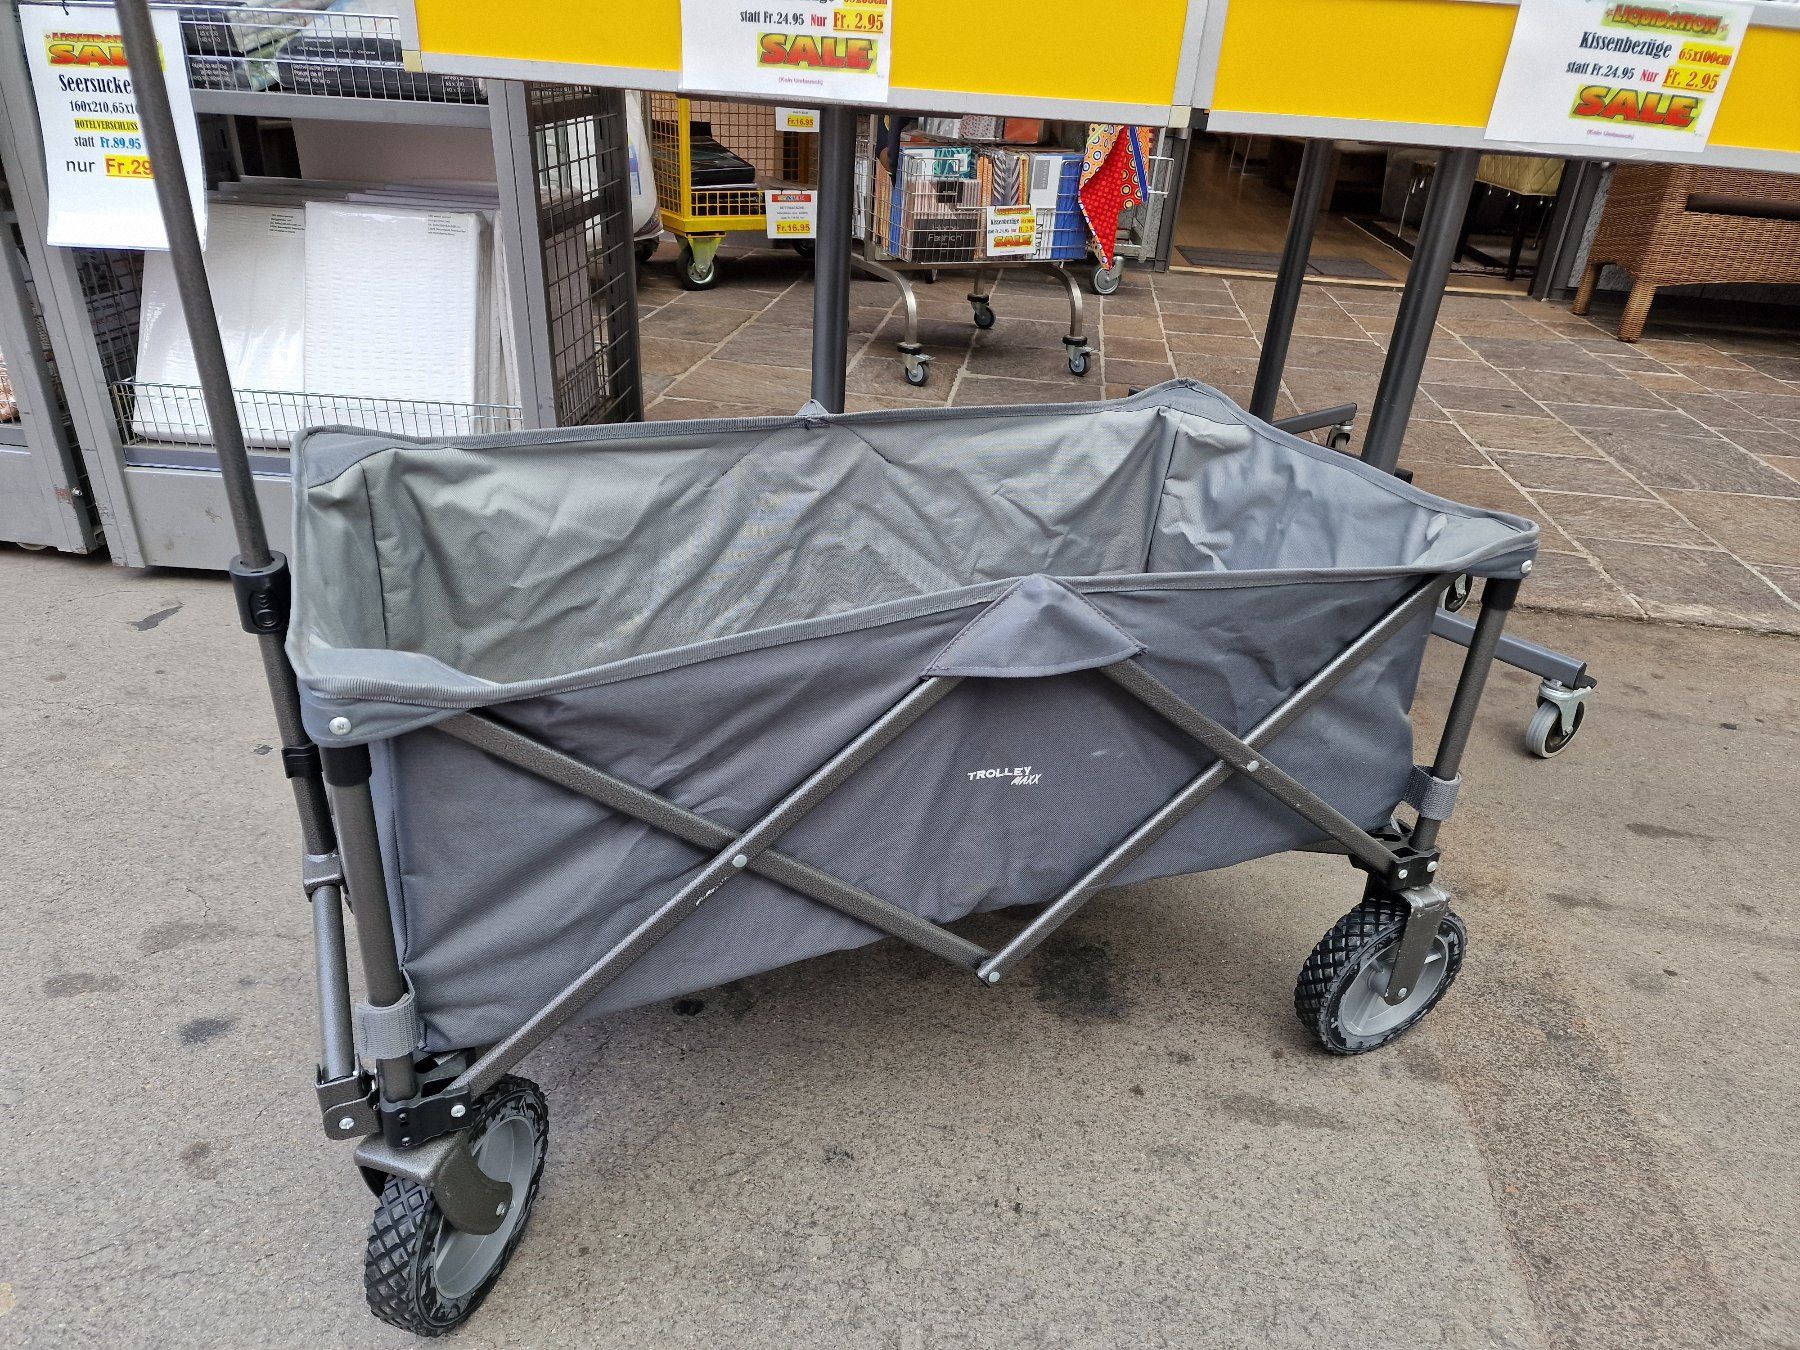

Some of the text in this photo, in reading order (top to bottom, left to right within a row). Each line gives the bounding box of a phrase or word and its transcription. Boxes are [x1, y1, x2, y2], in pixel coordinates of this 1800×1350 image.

[740, 10, 884, 30] statt Fr.24.95 Nur Fr. 2.95
[1612, 4, 1723, 34] LIQUIDATION
[49, 43, 129, 66] SAL
[760, 32, 873, 70] SALE
[1579, 31, 1732, 66] Kissenbezüge 65x100cm
[58, 74, 132, 94] Seersucke
[1566, 61, 1719, 90] statt Fr.24.95 Nur Fr. 2.95
[1573, 85, 1699, 128] SALE
[74, 119, 139, 131] HOTELVERSCHLUSS
[787, 117, 814, 126] Fr.16.95
[74, 135, 142, 149] statt Fr.89.95
[66, 159, 96, 172] nur
[776, 224, 811, 232] Fr.16.95
[993, 235, 1032, 248] SALE
[967, 766, 1031, 781] TROLLEY
[1010, 773, 1042, 785] MAXX
